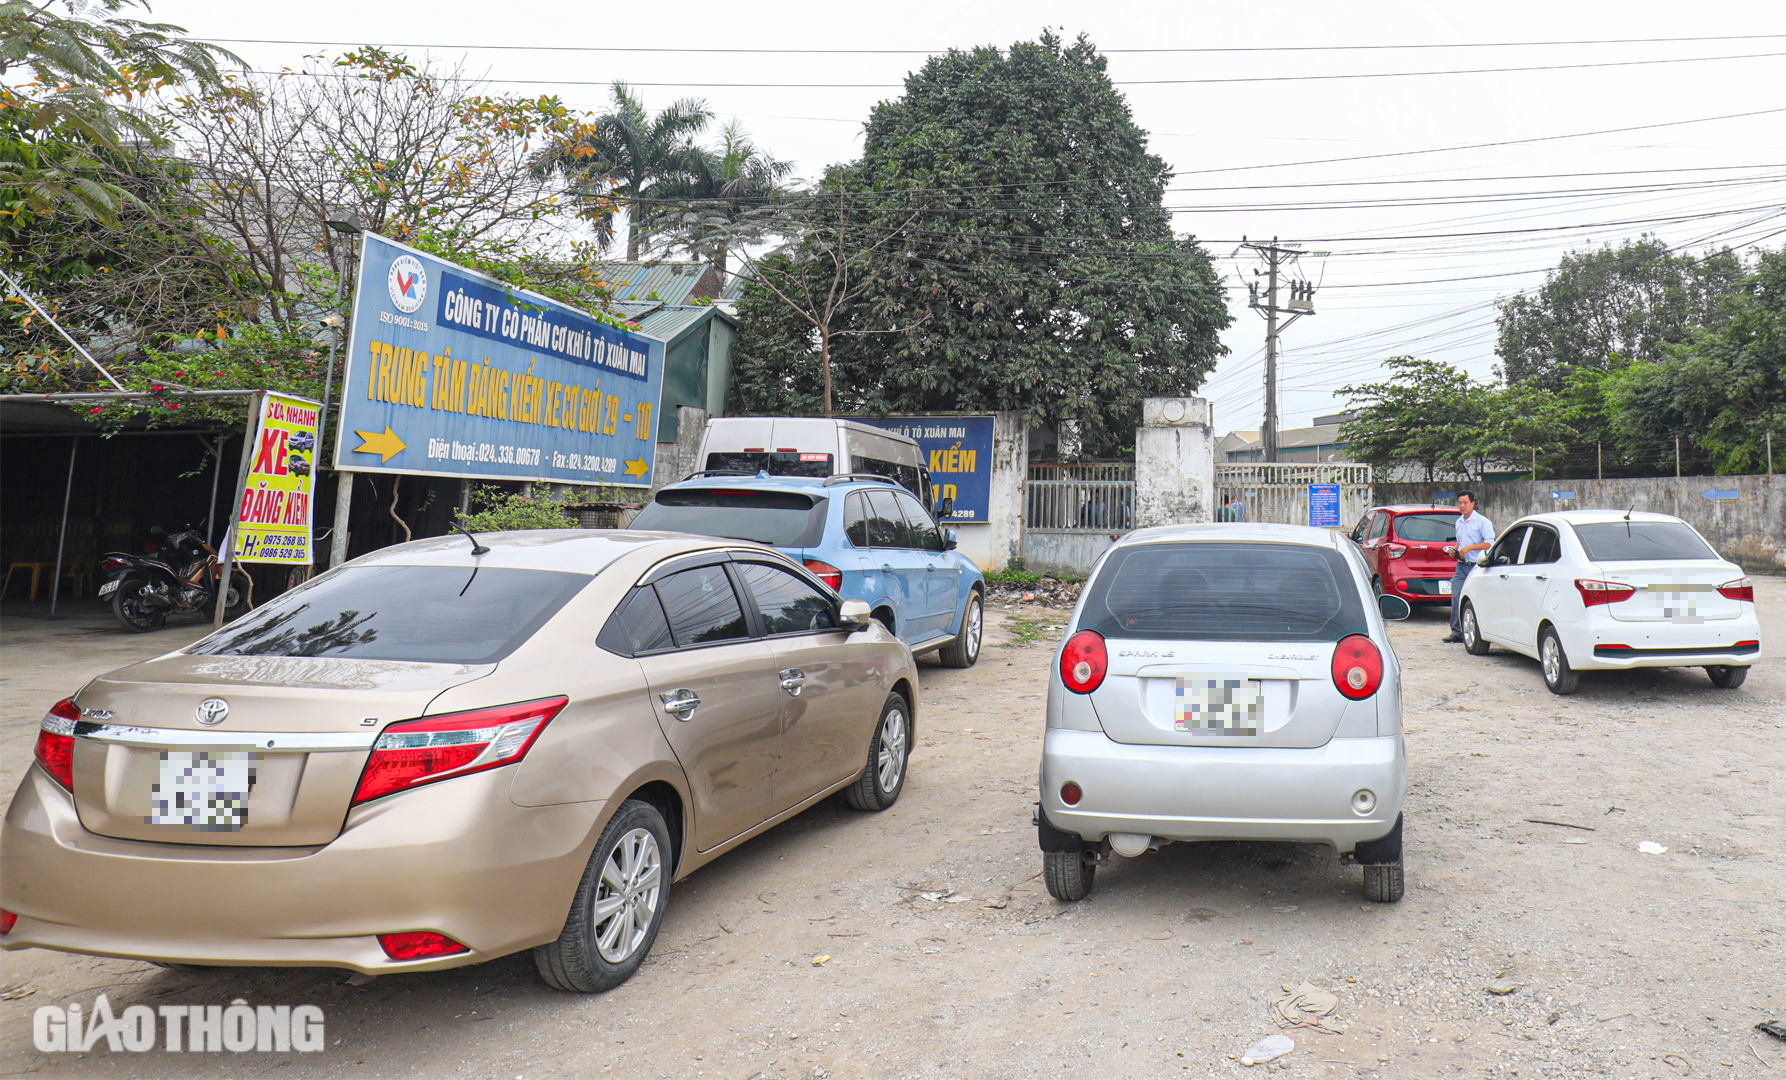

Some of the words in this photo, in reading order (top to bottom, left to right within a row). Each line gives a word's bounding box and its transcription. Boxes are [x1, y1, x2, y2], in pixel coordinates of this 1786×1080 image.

[380, 311, 393, 324] ISO
[444, 288, 482, 329] CÔNG
[485, 304, 500, 334] TY
[520, 311, 551, 349] PHẦN
[551, 325, 567, 353] CƠ
[566, 329, 584, 358] KHÍ
[584, 331, 591, 360] Ô
[593, 336, 605, 364] TÔ
[605, 342, 629, 371] XUÂN
[629, 350, 646, 376] MAI
[367, 340, 428, 408] TRUNG
[431, 346, 467, 413] TÂM
[466, 356, 509, 420] ĐĂNG
[509, 357, 544, 425] KIỂM
[543, 380, 562, 428] XE
[561, 383, 580, 431] CƠ
[578, 378, 603, 434] GIỚI
[602, 394, 619, 437] 29
[635, 401, 652, 441] 11D
[286, 406, 317, 427] NHANH
[912, 425, 921, 438] TÔ
[924, 425, 947, 438] XUÂN
[949, 427, 965, 438] MAI
[252, 428, 289, 476] XE
[427, 438, 450, 462] Điện
[929, 441, 976, 473] KIỂM
[239, 482, 284, 524] ĐĂNG
[283, 479, 308, 526] KIỂM
[263, 534, 282, 546] 0975
[282, 535, 297, 546] 268
[259, 547, 278, 558] 0986
[279, 548, 293, 559] 529
